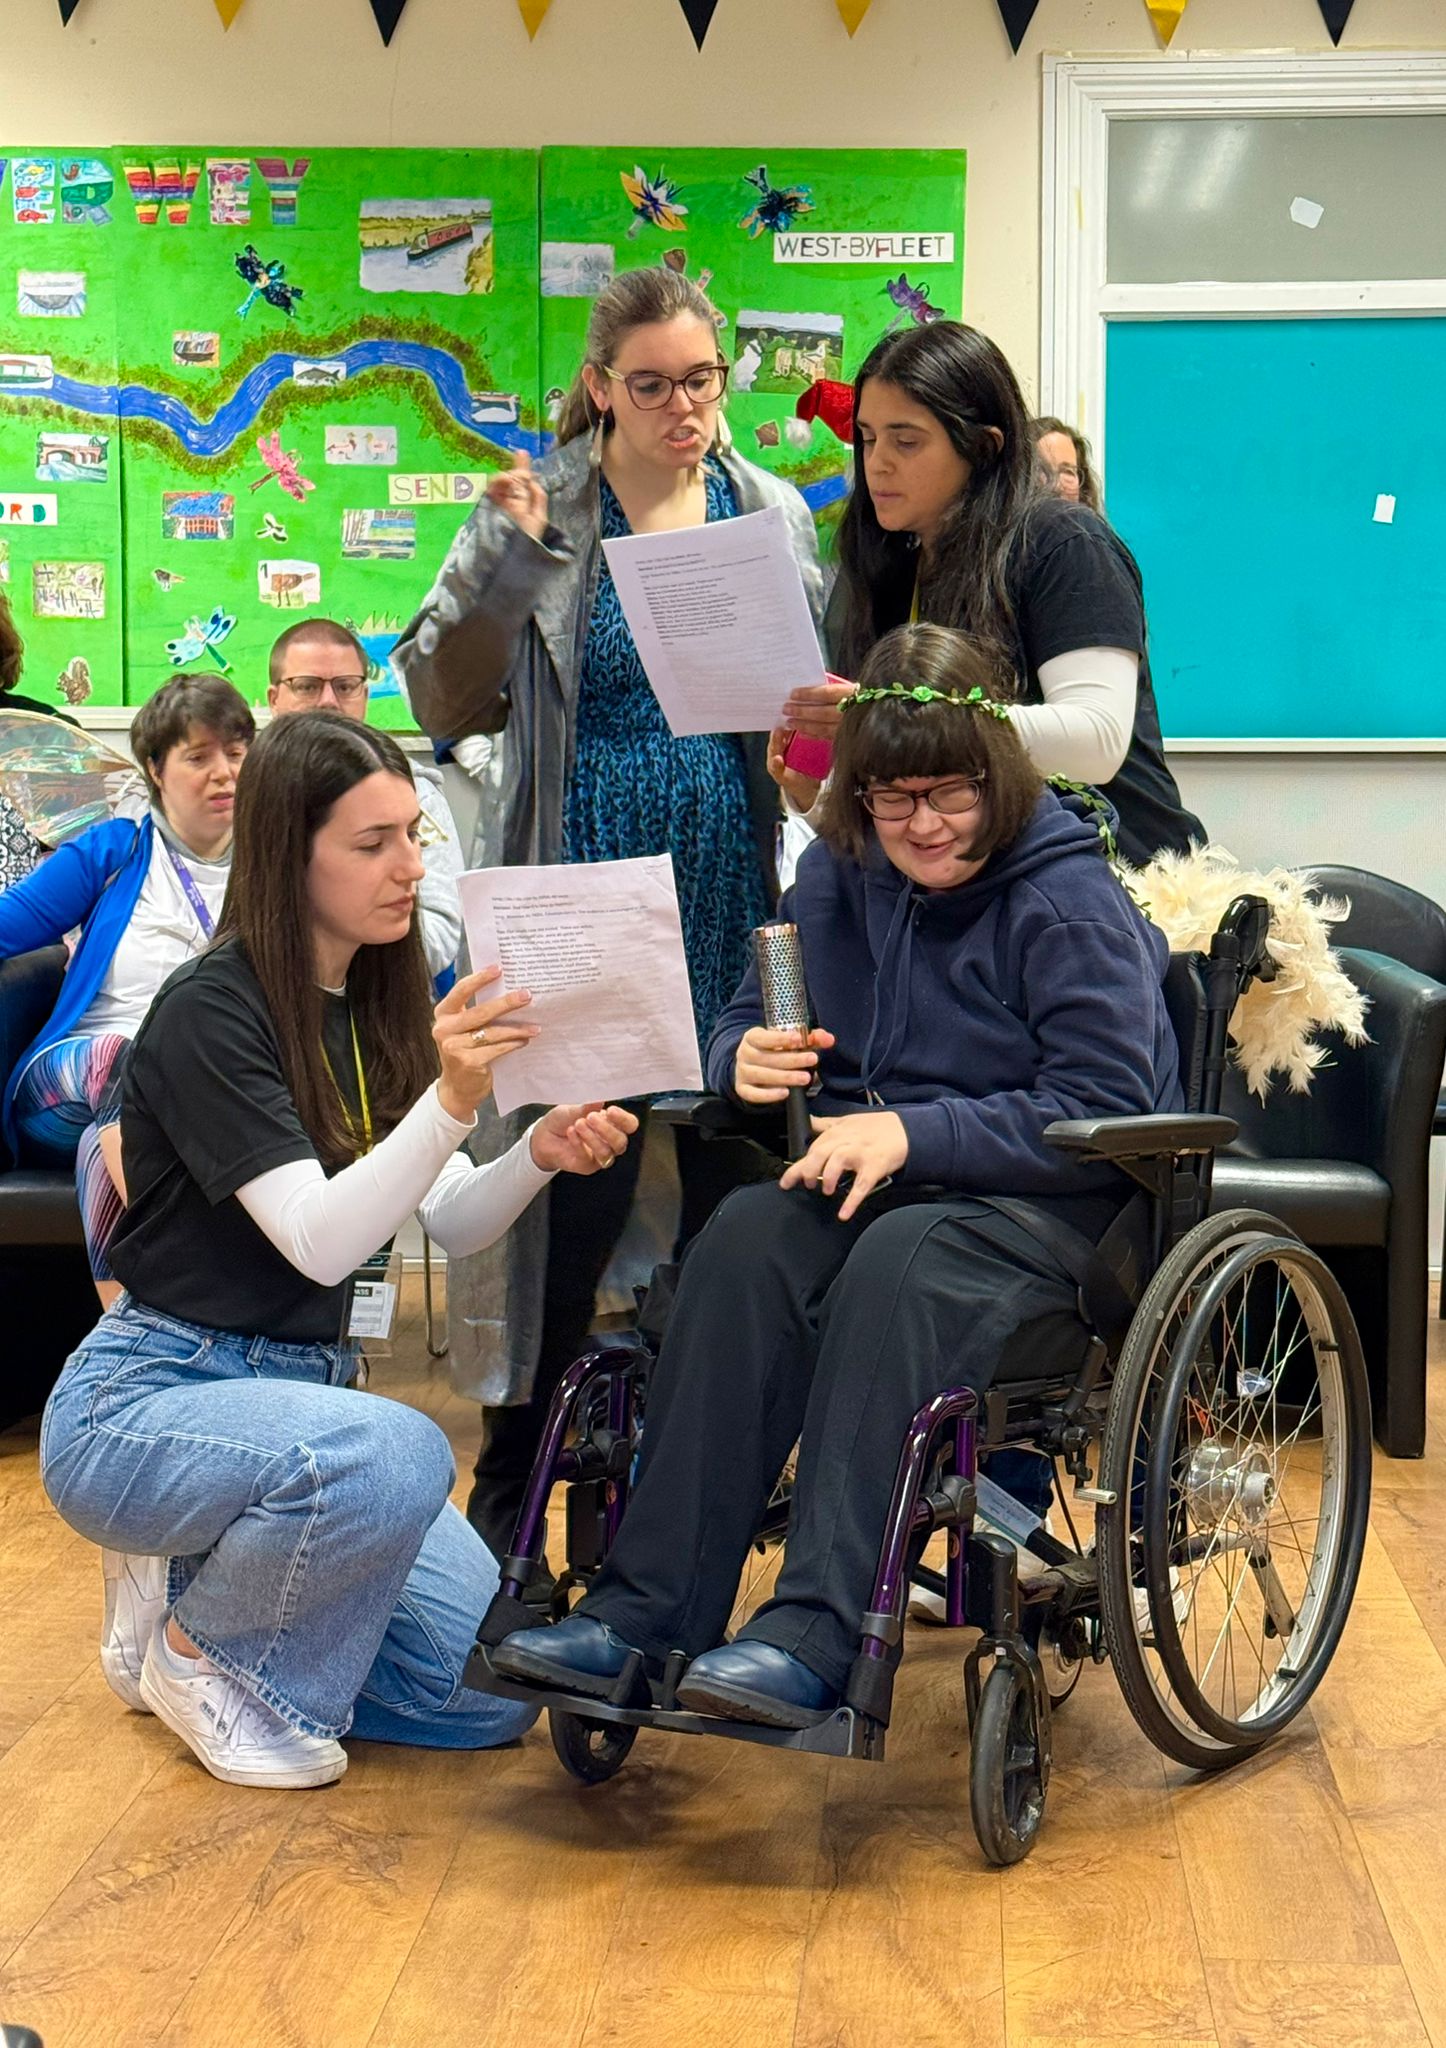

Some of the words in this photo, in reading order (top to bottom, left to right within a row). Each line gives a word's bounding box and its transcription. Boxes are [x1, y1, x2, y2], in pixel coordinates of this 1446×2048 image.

[0, 157, 113, 226] ER
[122, 157, 312, 226] WEY
[778, 236, 945, 258] WEST-BYFLEET
[394, 475, 473, 501] SEND
